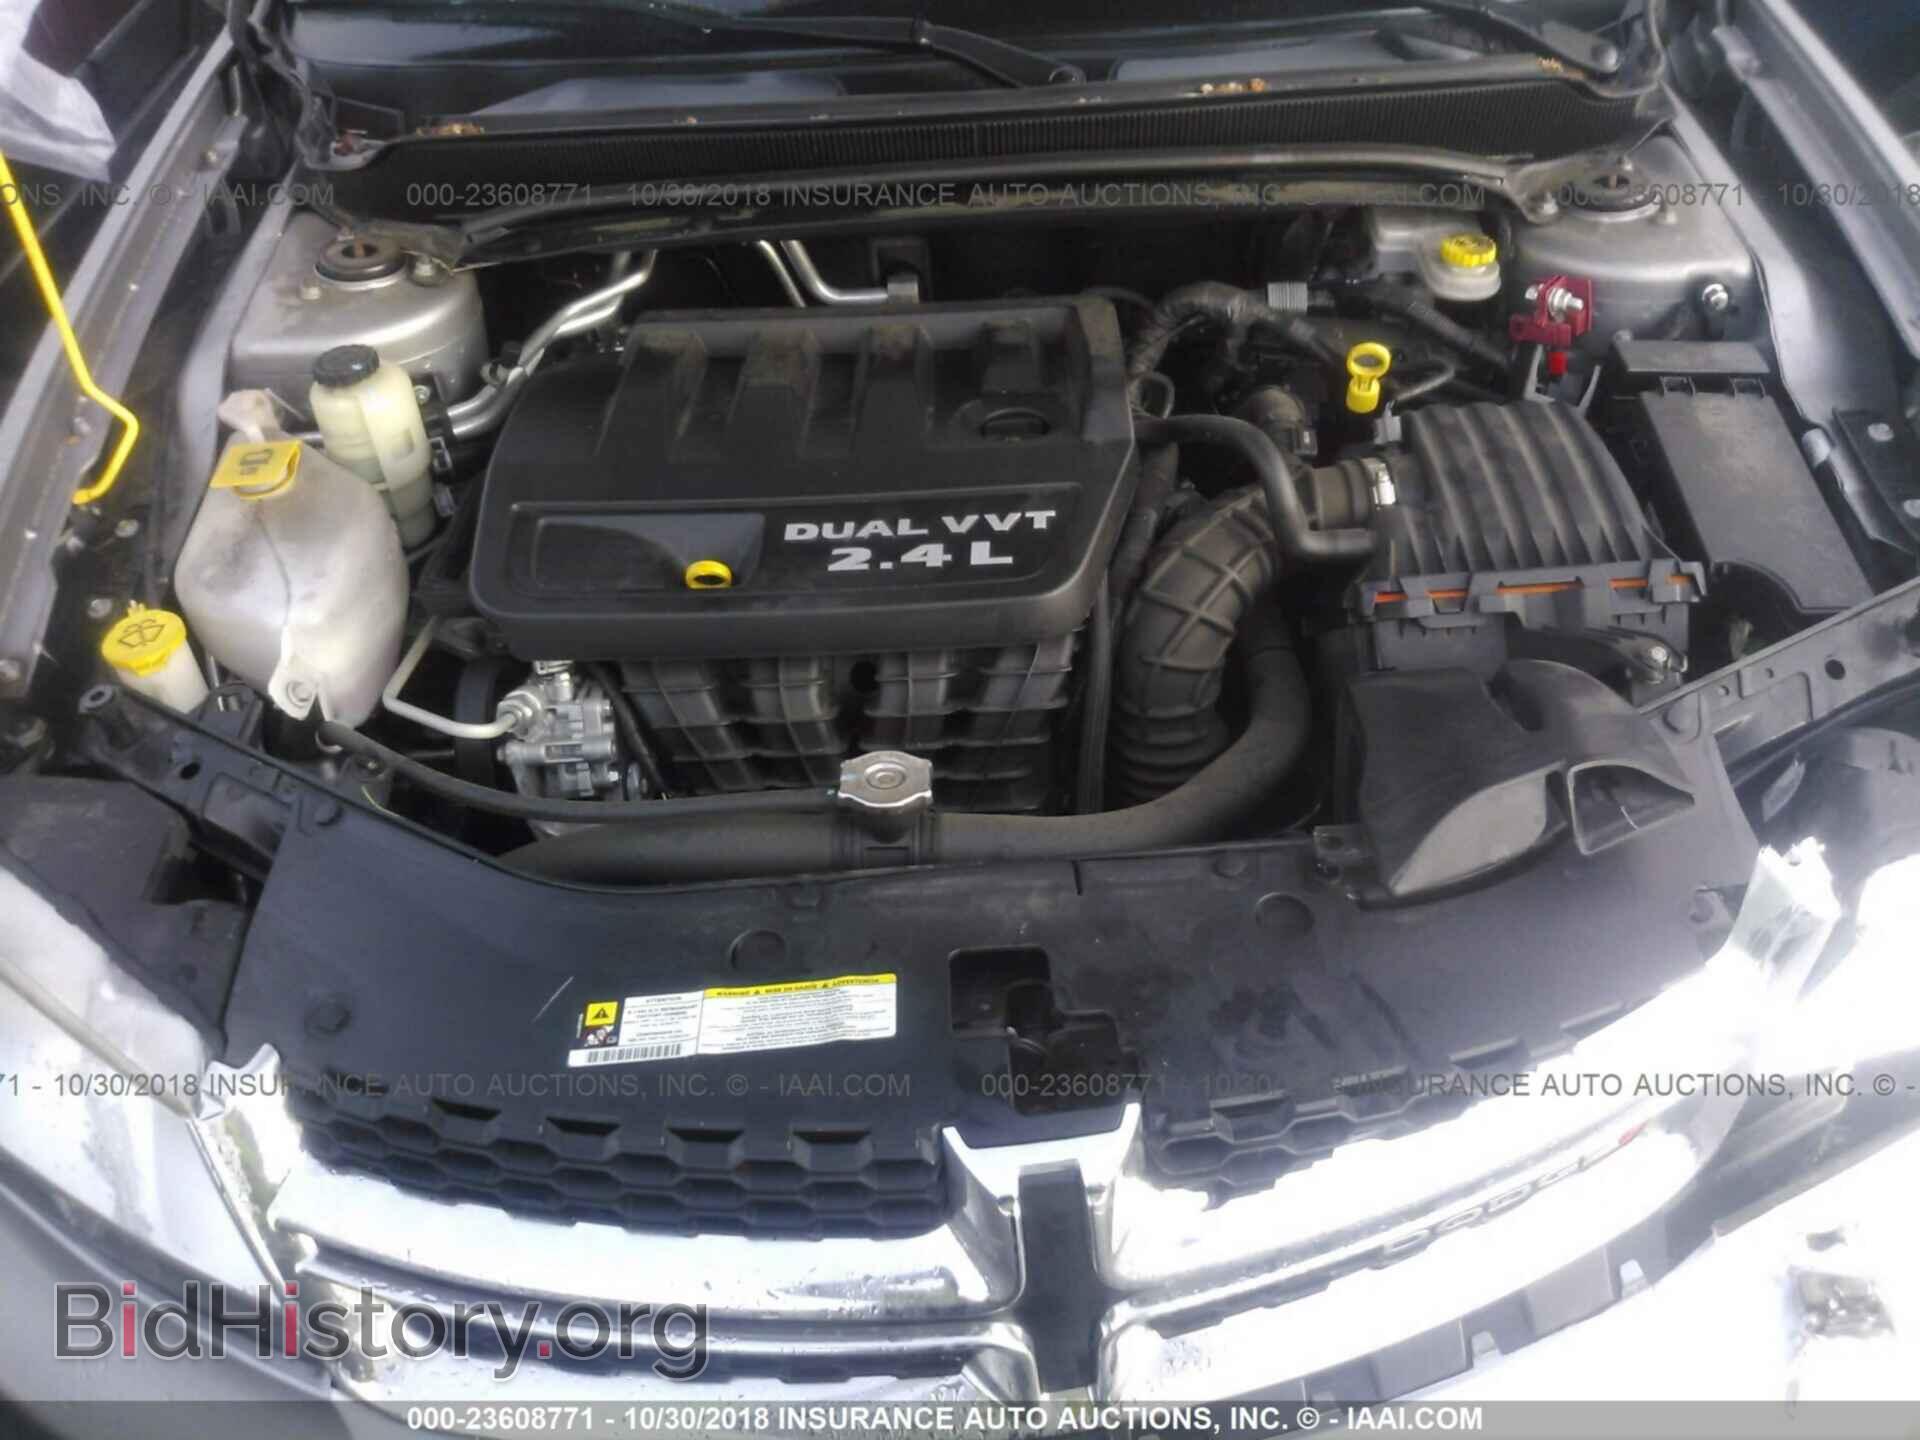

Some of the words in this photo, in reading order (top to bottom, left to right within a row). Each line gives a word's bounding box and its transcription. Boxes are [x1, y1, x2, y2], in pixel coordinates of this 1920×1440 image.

[784, 519, 929, 541] DUAL
[941, 509, 1057, 534] VVT
[827, 543, 952, 571] 2.4
[970, 541, 1014, 566] L
